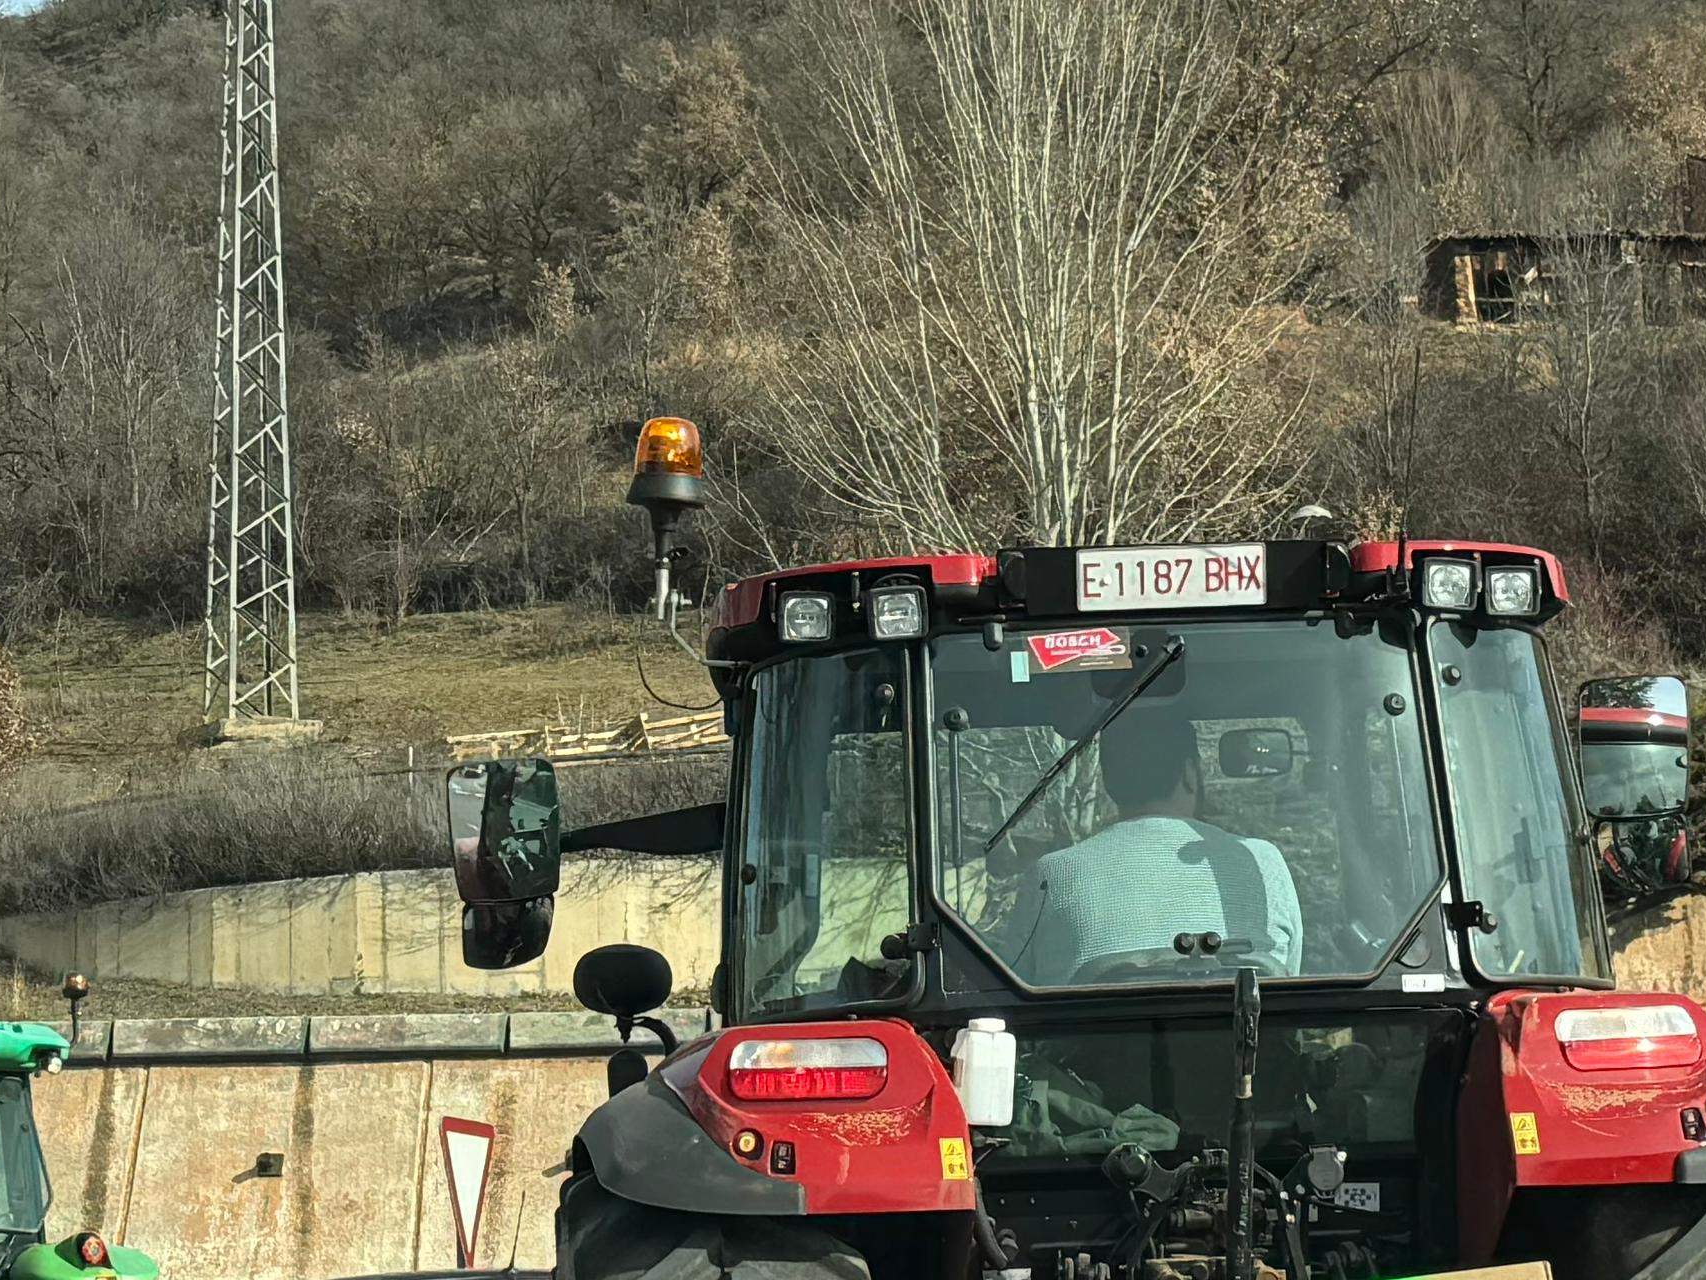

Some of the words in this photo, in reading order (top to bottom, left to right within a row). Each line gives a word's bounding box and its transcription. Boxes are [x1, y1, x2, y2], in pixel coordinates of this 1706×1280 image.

[1082, 562, 1102, 598] E
[1114, 556, 1193, 597] 1187
[1204, 554, 1262, 593] BHX
